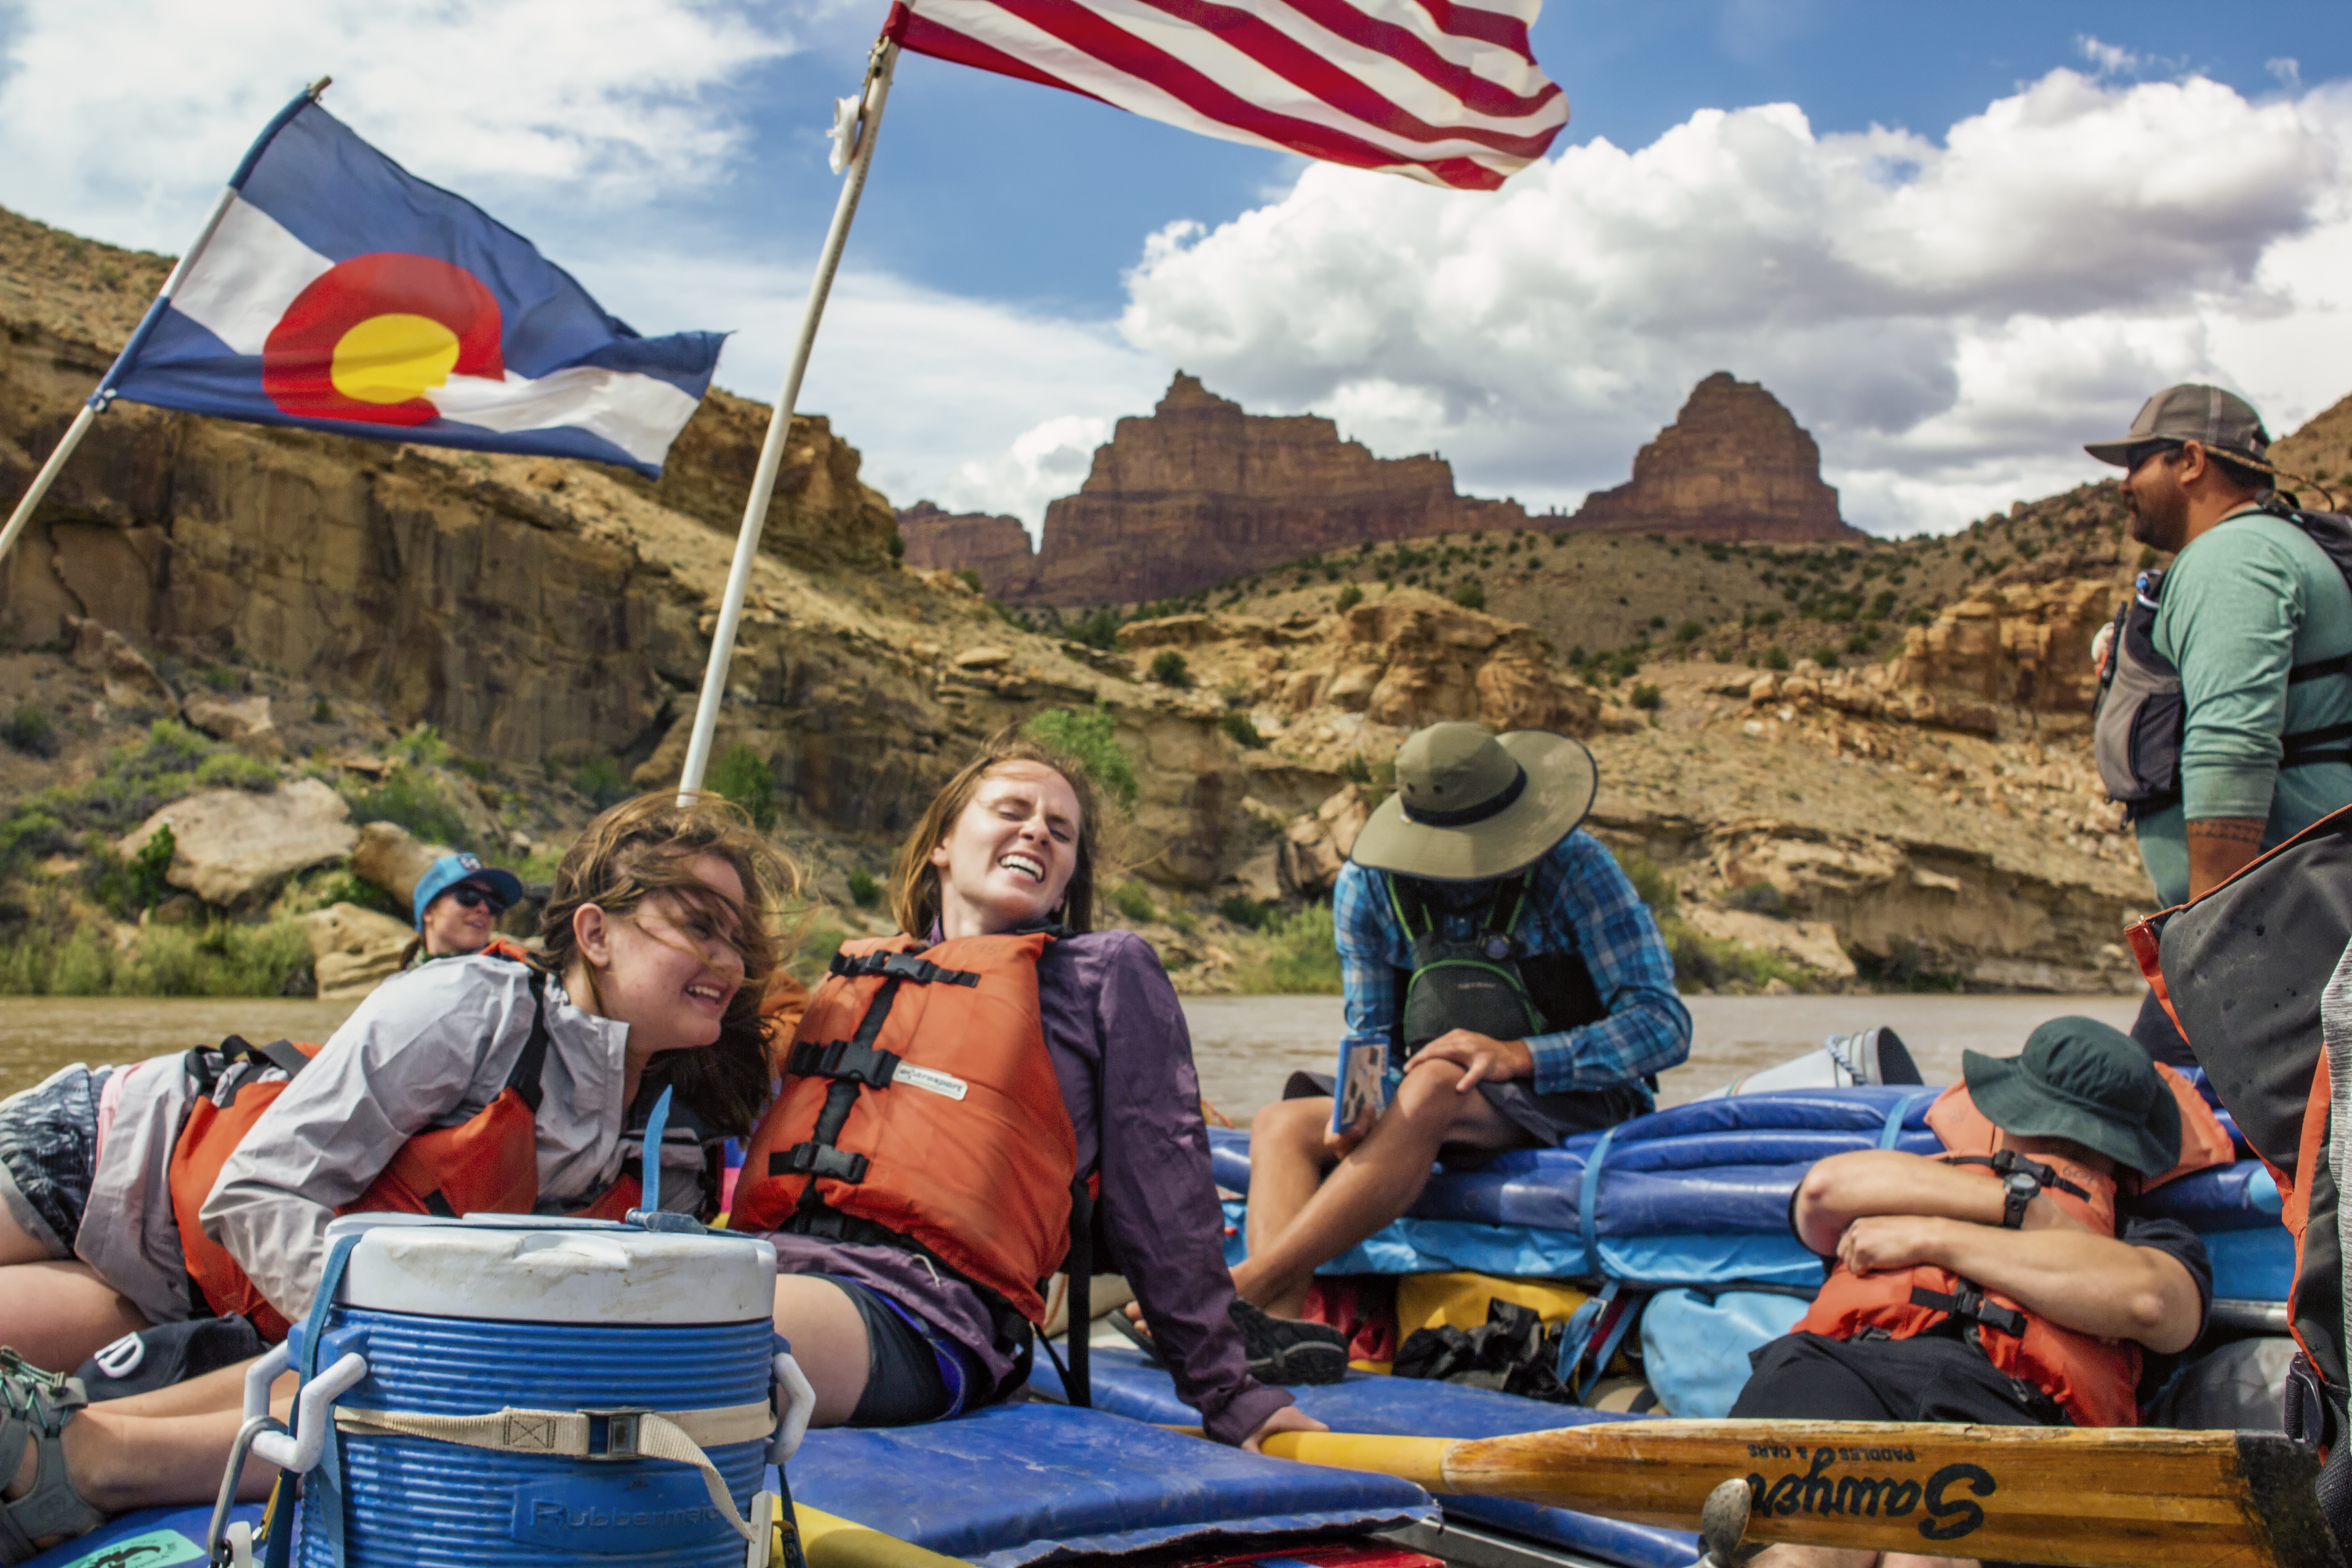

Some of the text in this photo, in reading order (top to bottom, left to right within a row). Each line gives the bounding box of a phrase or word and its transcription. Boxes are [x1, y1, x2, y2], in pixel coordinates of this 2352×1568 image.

[1748, 1444, 1791, 1459] OARS
[1838, 1446, 1916, 1462] PADDLES
[1746, 1446, 1996, 1540] Sawyer
